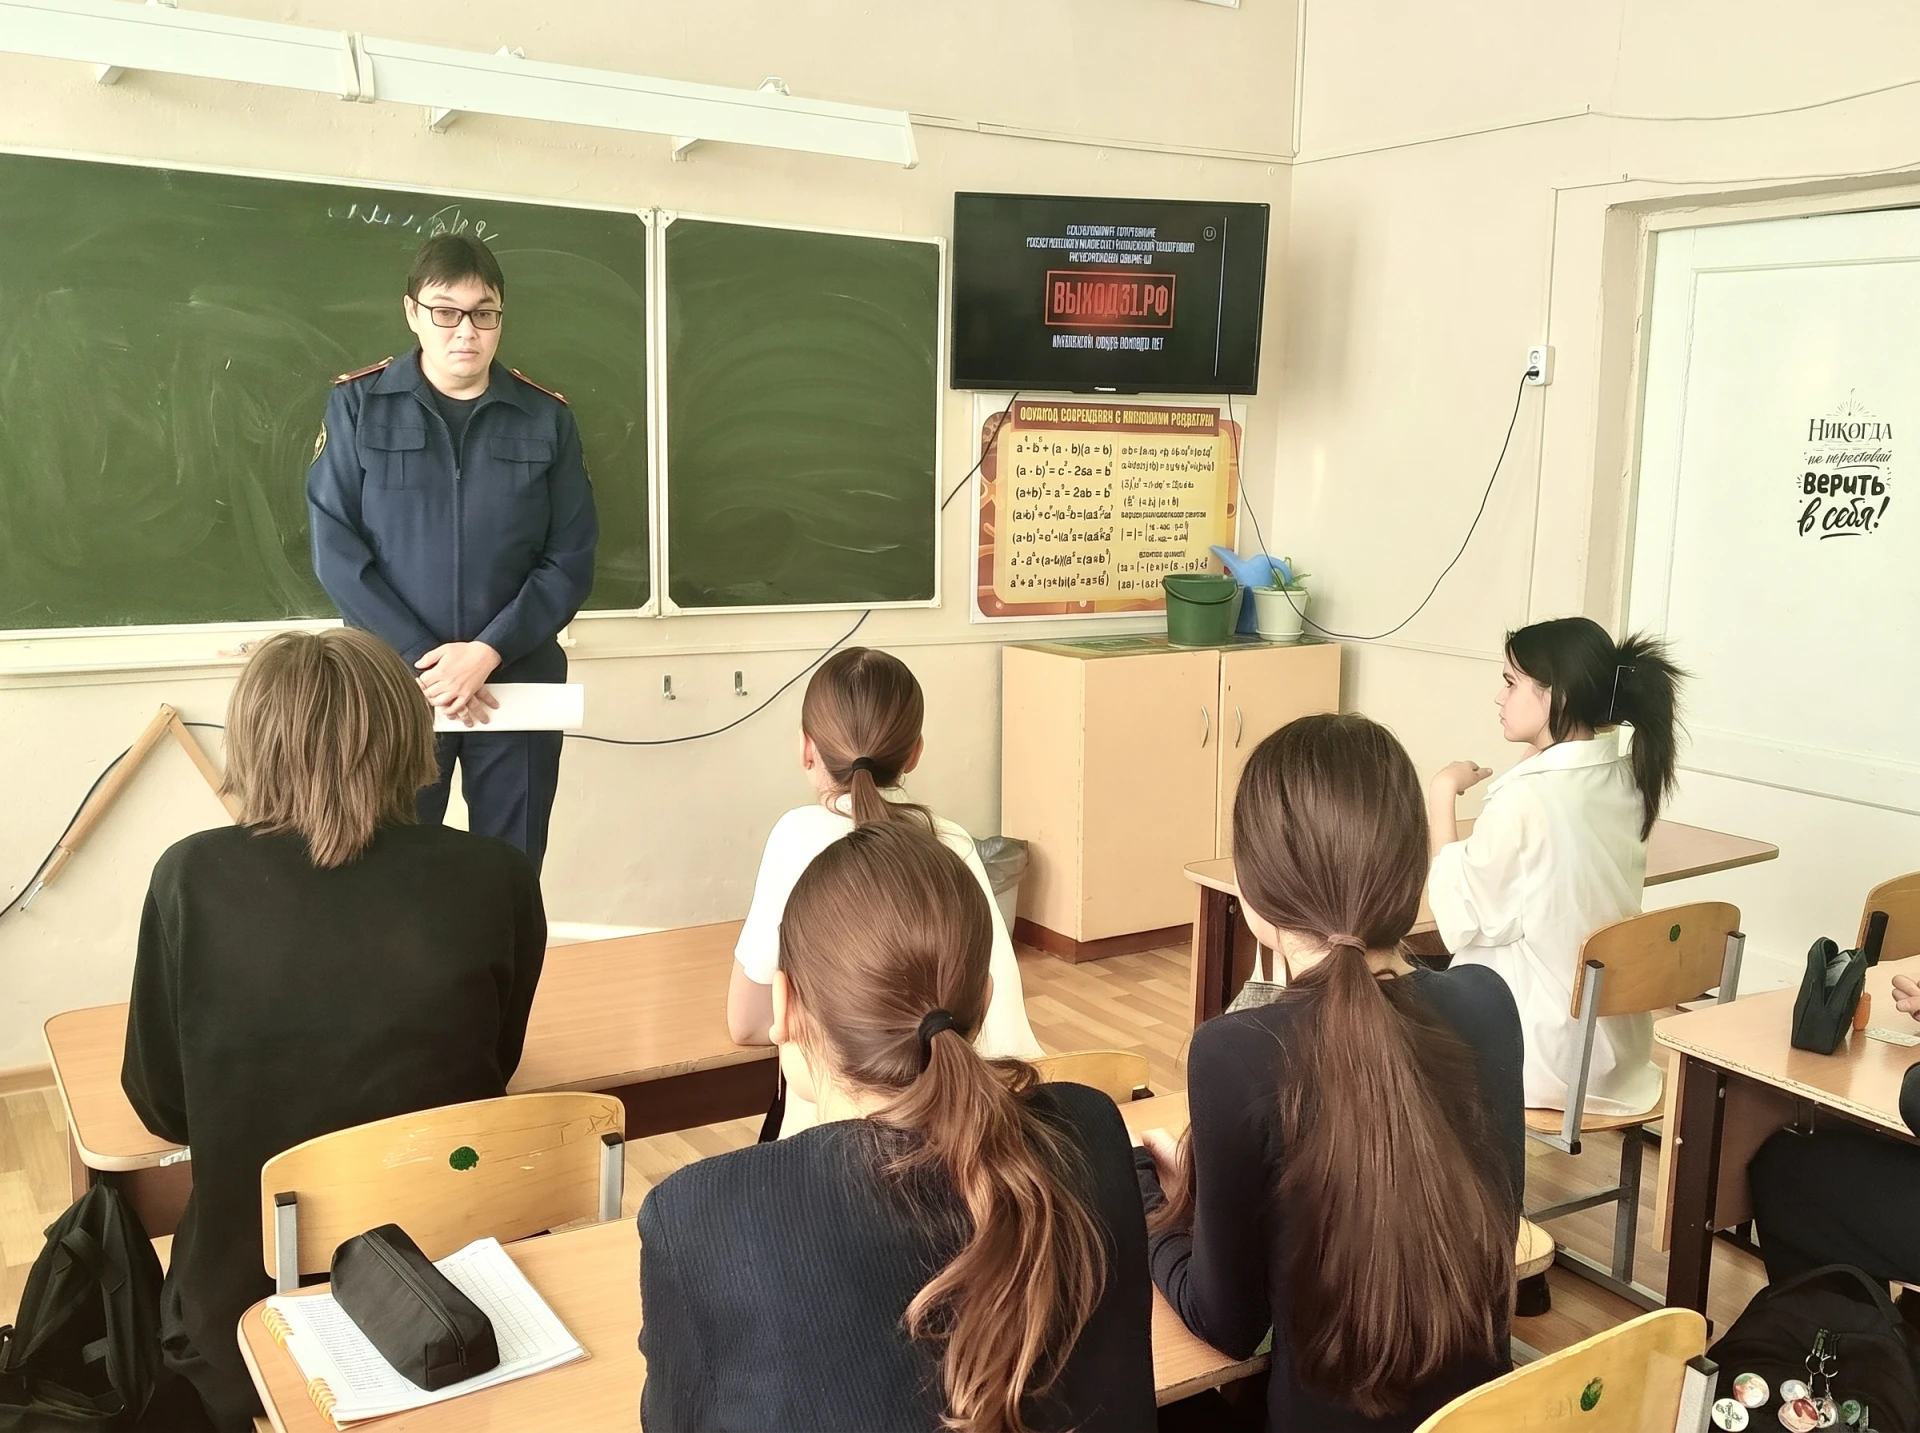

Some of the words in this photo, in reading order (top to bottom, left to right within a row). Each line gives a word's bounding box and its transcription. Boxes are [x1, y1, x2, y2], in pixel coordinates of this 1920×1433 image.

[1053, 281, 1169, 319] ВЫХОД31.РФ
[1808, 455, 1824, 465] не
[1798, 497, 1822, 537] в
[1822, 496, 1891, 531] себя!
